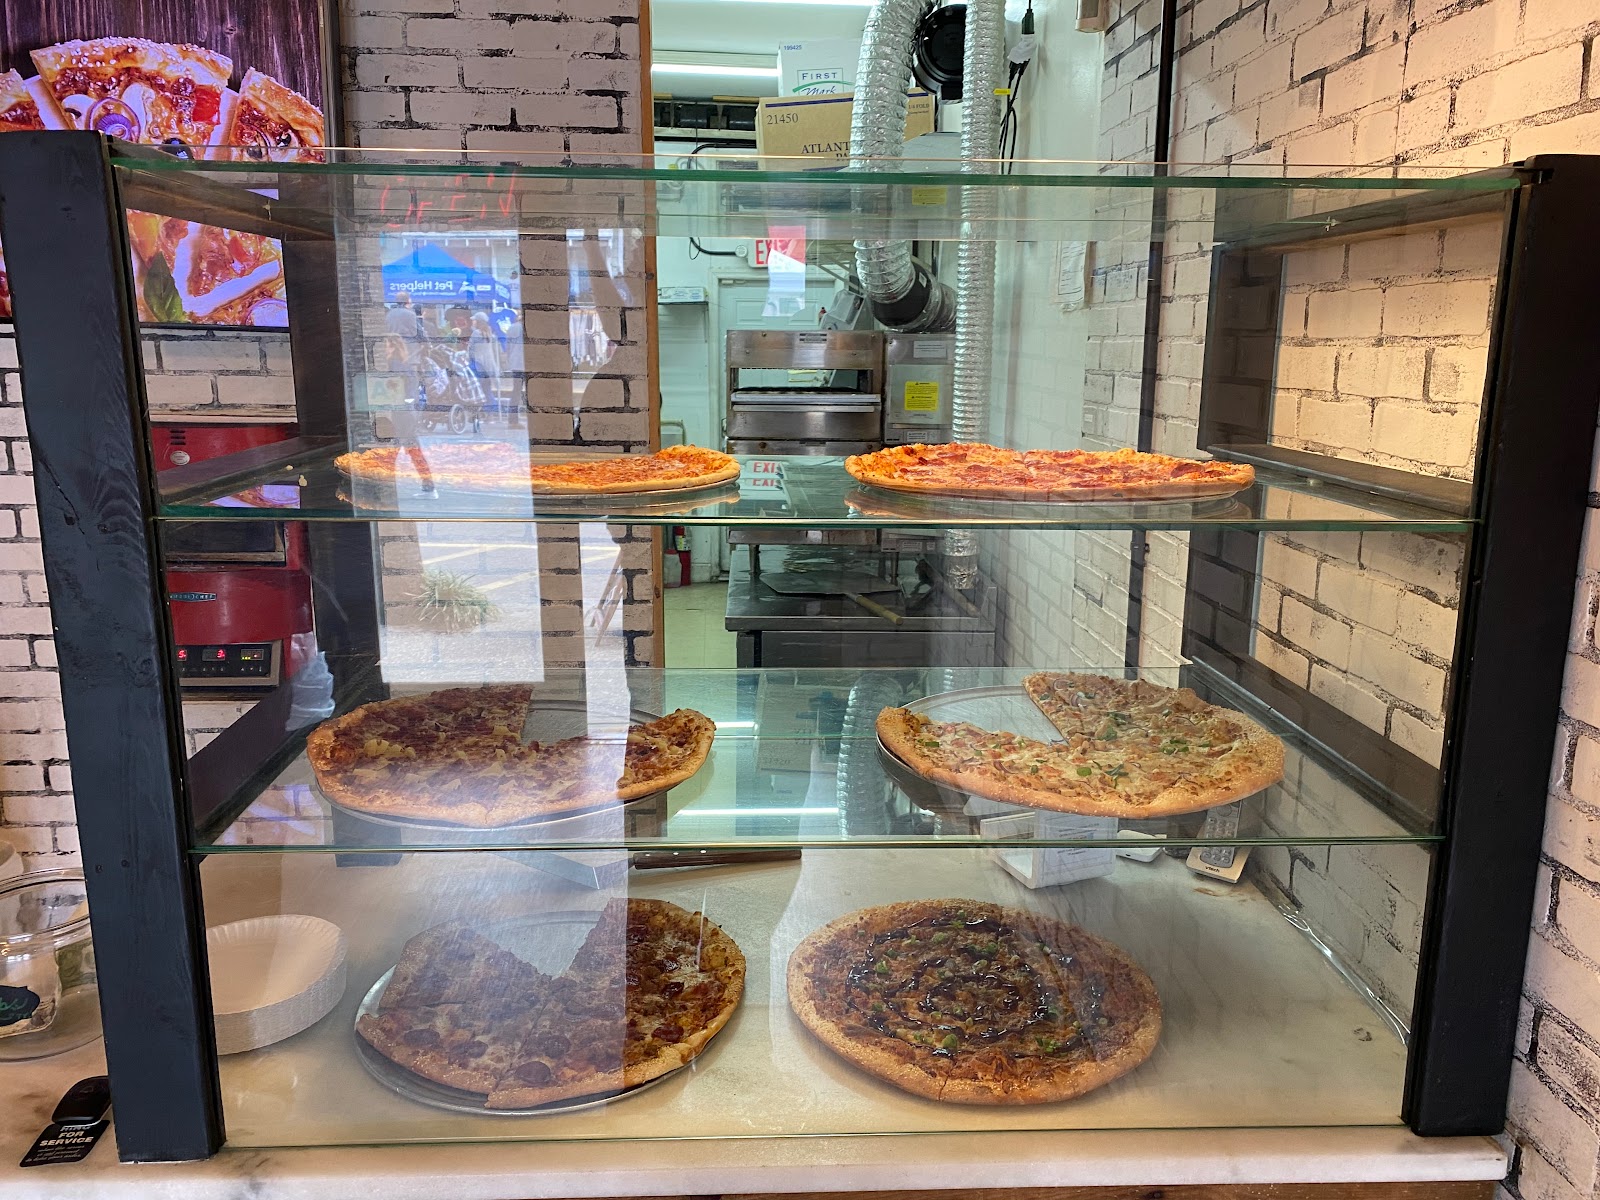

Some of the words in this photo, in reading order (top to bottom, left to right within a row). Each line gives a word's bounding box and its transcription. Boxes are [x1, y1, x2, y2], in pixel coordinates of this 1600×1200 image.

[802, 72, 837, 80] FIRST
[801, 86, 836, 95] Mark
[767, 112, 799, 125] 21450
[40, 1136, 94, 1146] SERVICE
